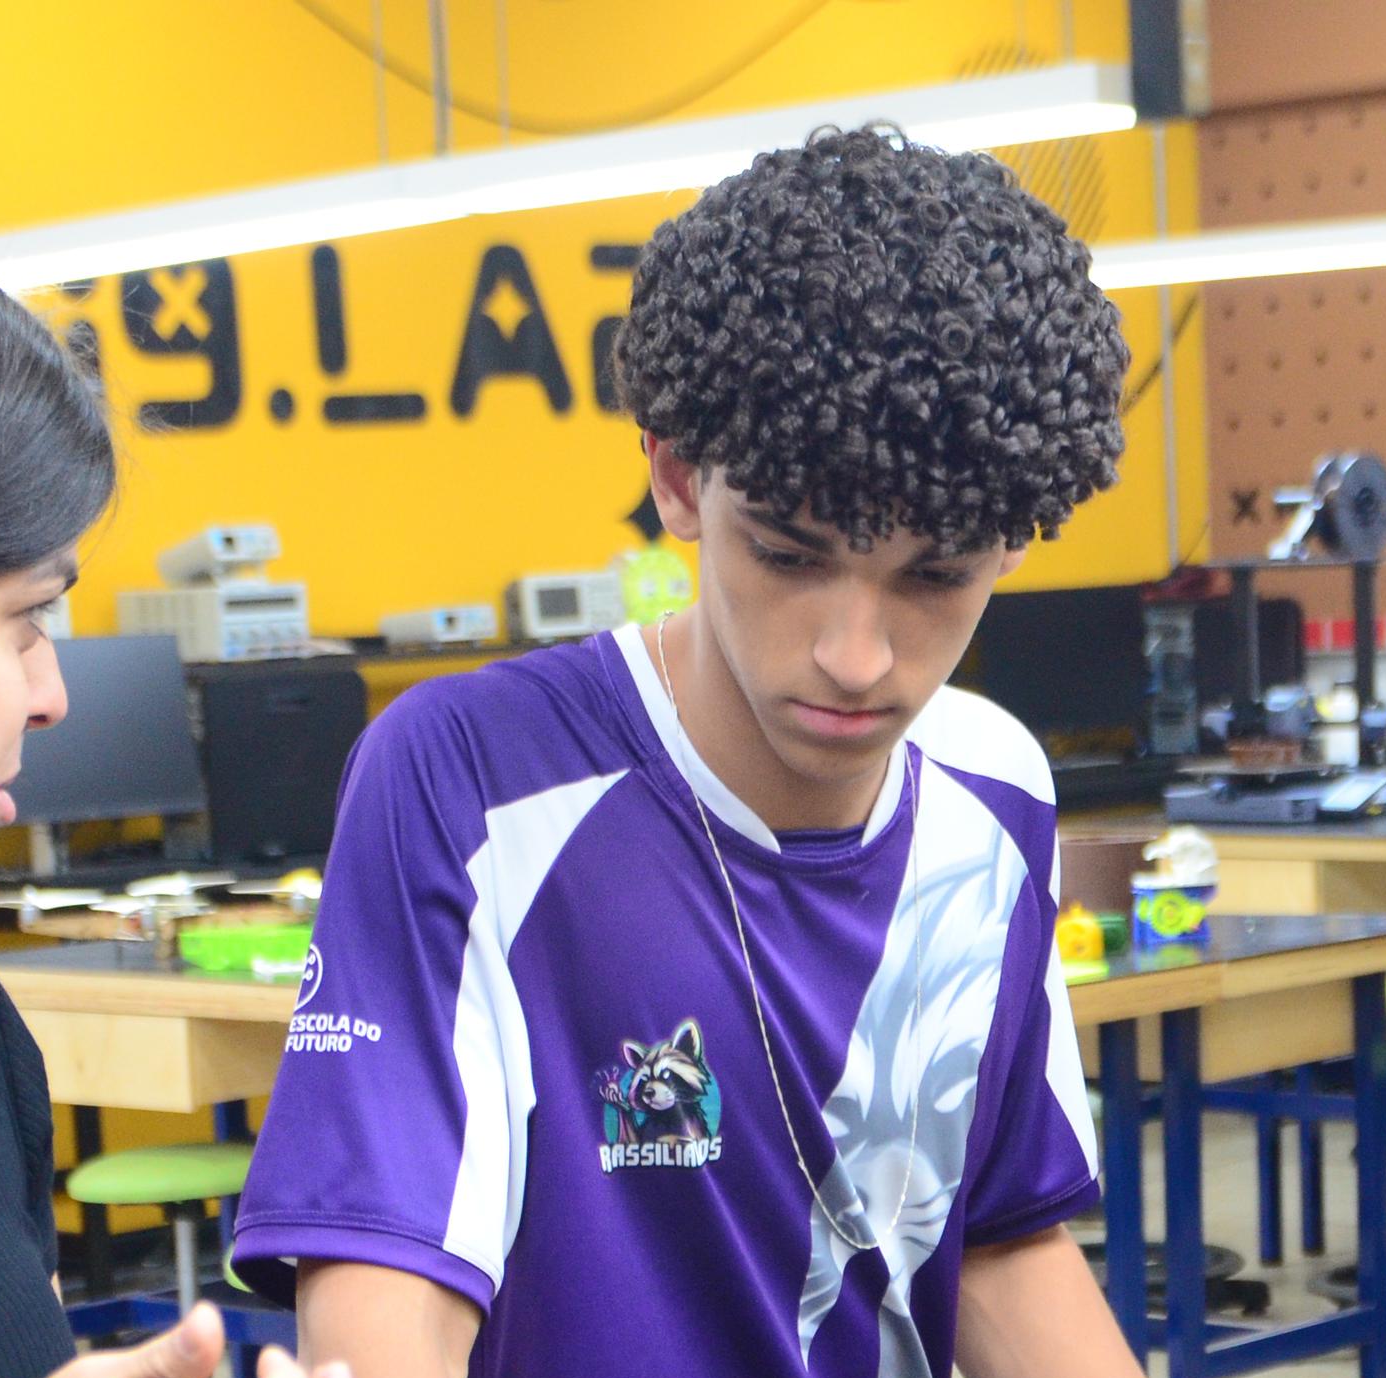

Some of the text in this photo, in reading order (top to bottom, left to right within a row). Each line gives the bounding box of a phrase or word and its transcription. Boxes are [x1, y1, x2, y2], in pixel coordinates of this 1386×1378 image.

[289, 1014, 382, 1042] ESCOLA DO
[285, 1033, 353, 1053] FUTURO
